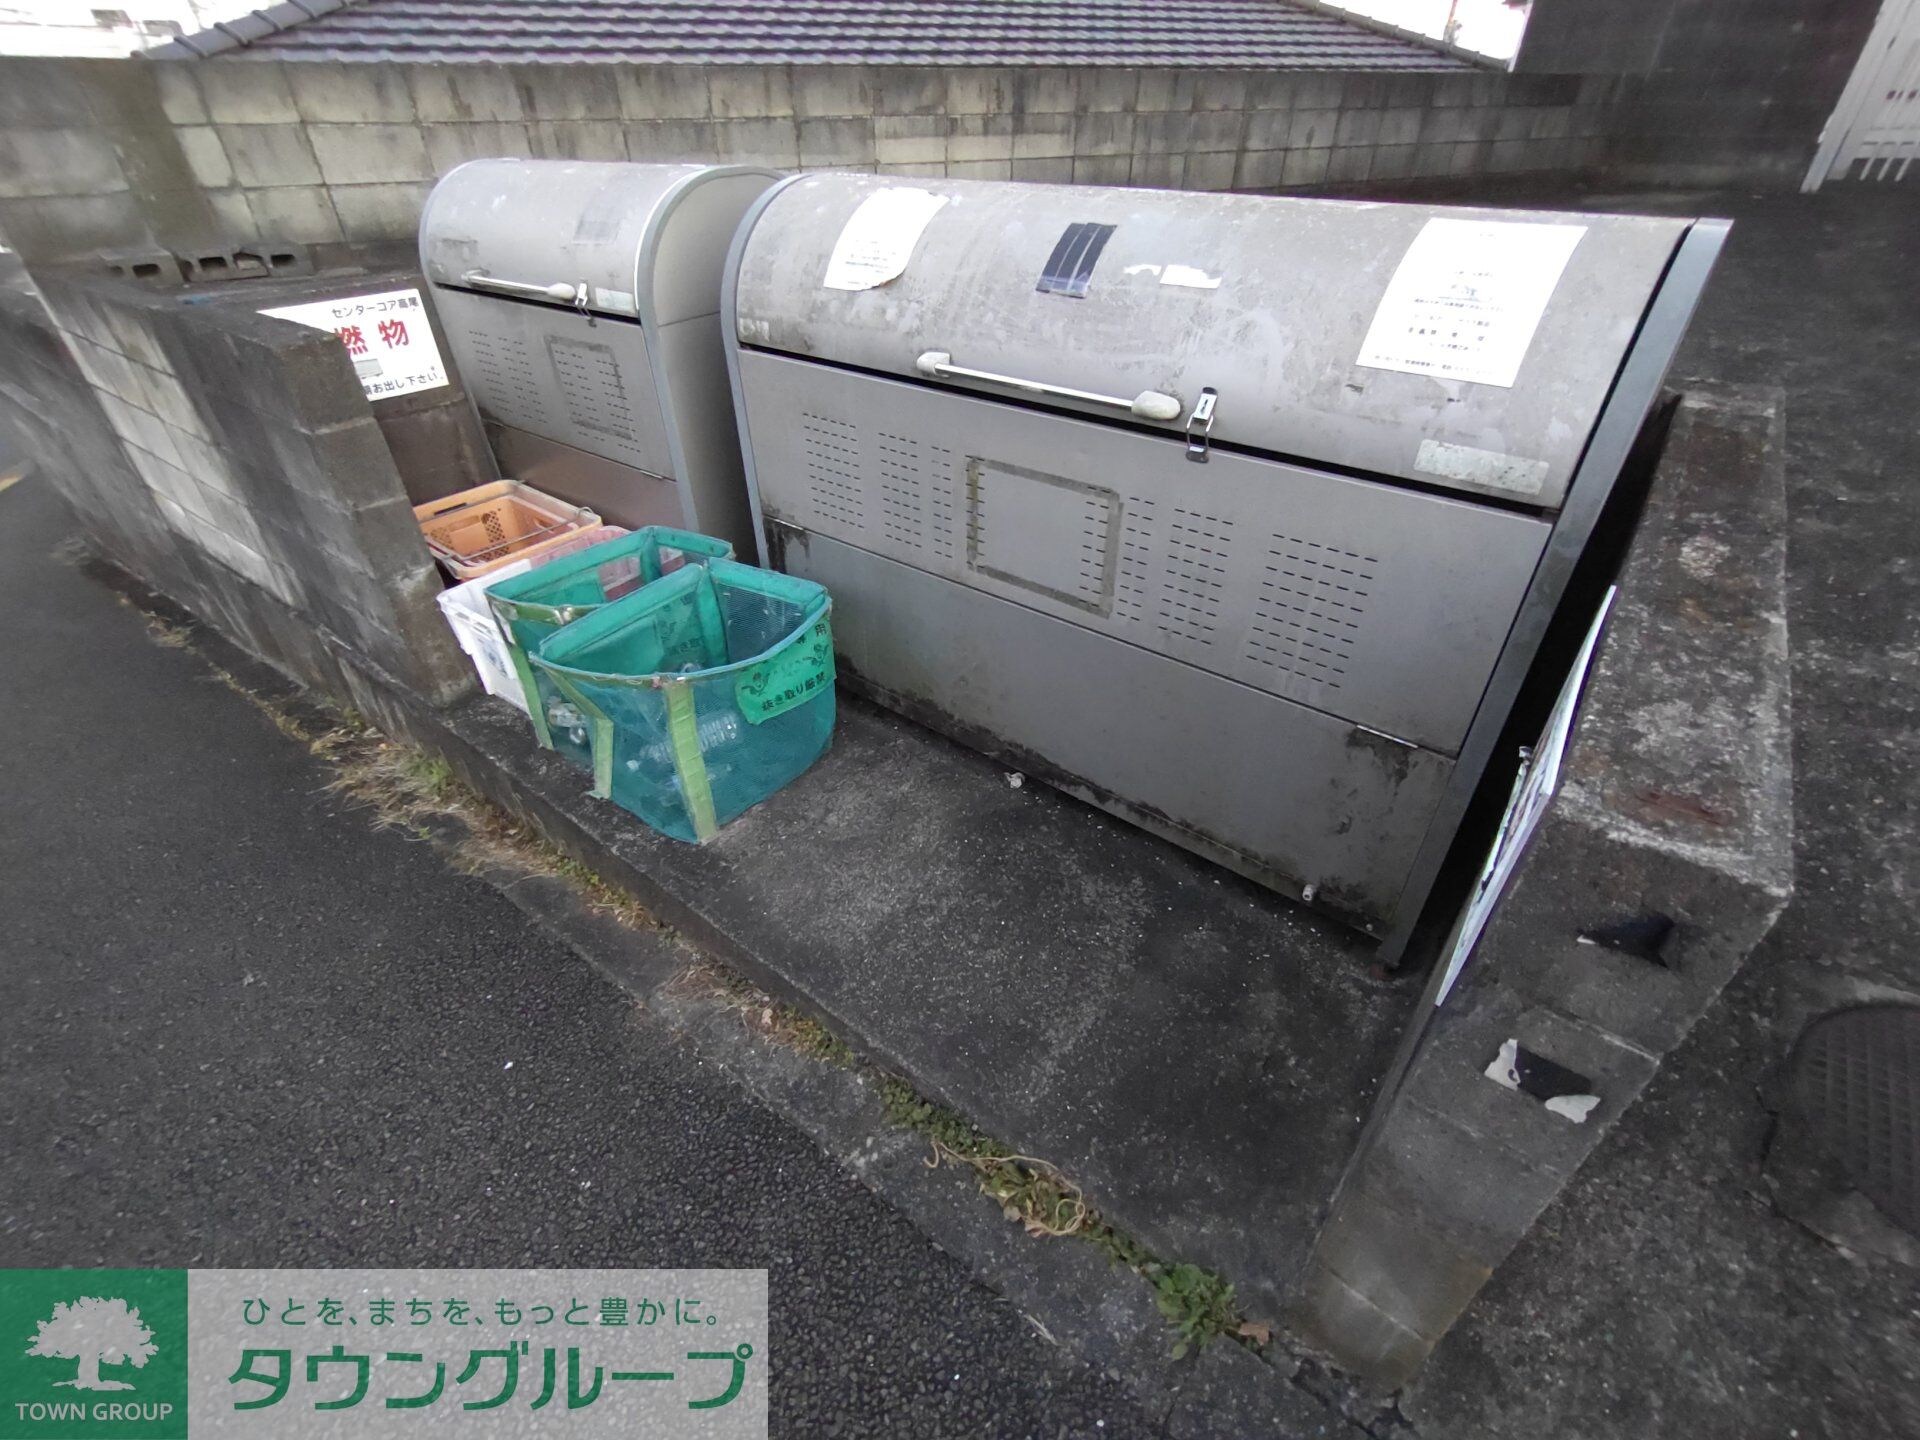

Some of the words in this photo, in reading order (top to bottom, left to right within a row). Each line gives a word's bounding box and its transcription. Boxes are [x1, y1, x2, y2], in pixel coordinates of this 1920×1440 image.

[332, 297, 419, 318] センターコア高尾
